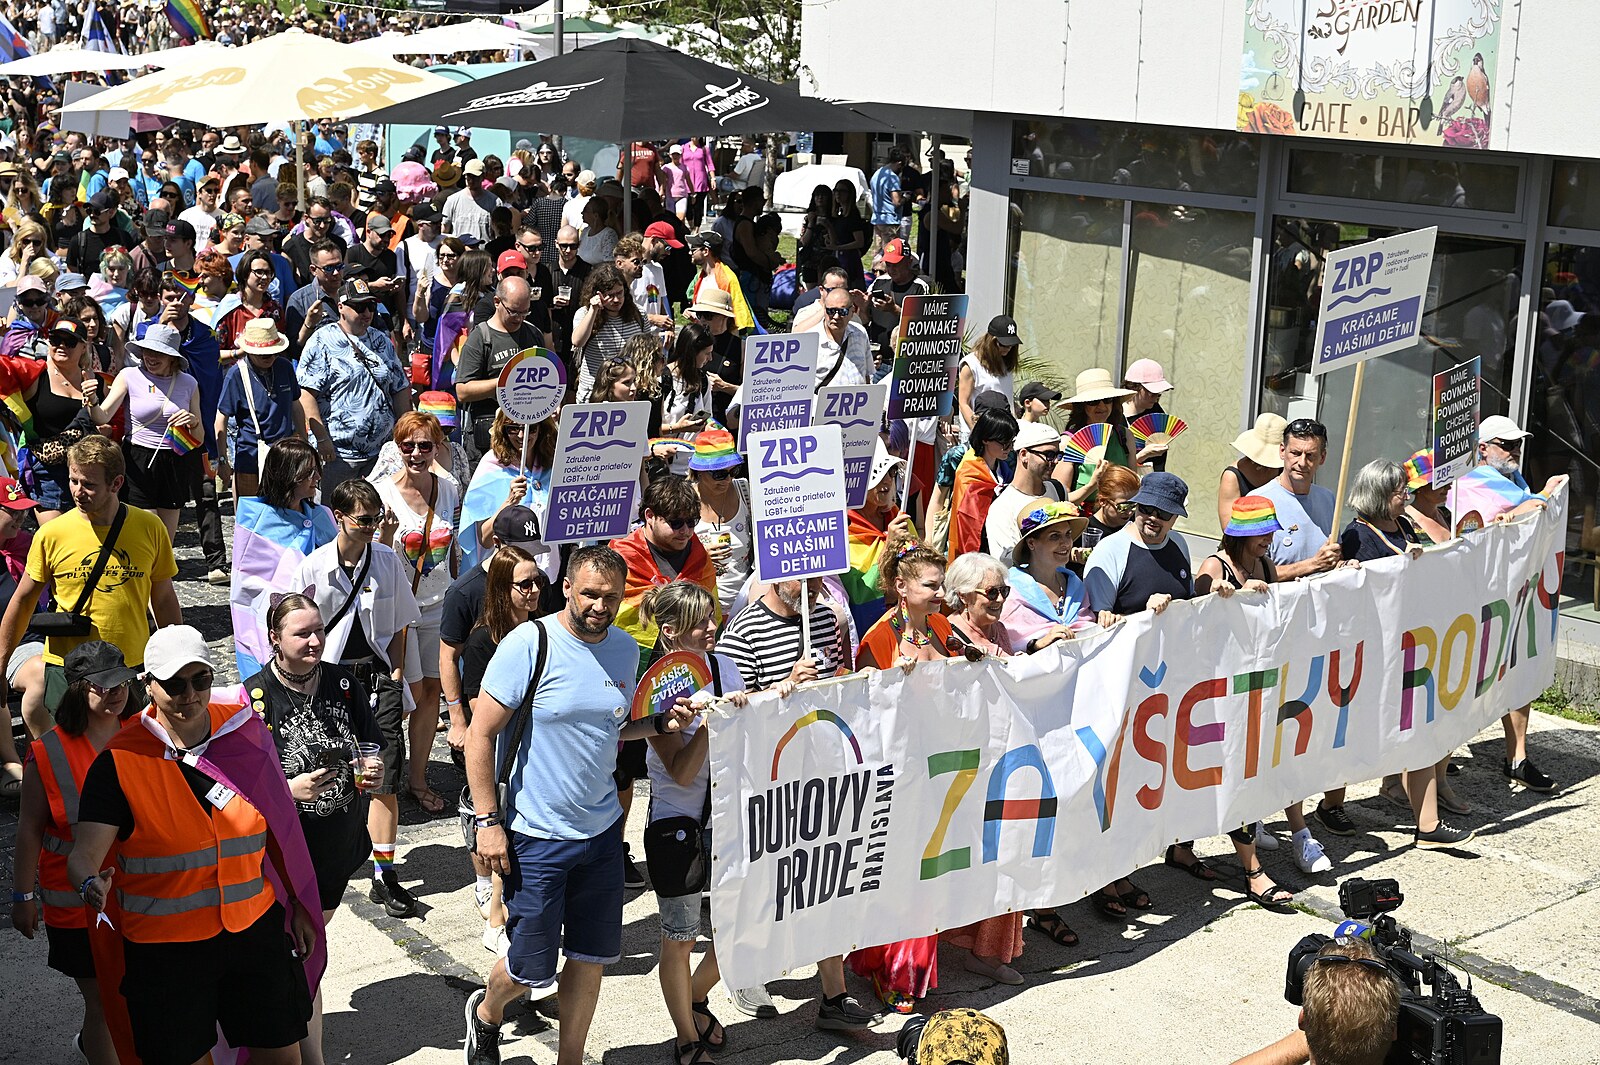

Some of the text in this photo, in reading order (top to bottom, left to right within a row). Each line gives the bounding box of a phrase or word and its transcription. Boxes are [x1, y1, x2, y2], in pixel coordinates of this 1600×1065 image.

[1334, 0, 1423, 55] GARDEN
[305, 68, 398, 114] MATTONI
[699, 85, 761, 118] Schweppes
[1300, 101, 1421, 139] CAFE BAR
[1331, 251, 1384, 294] ZRP
[922, 300, 949, 316] MÁME
[907, 316, 958, 336] ROVNAKÉ
[1341, 307, 1399, 335] KRÁČAME
[900, 339, 959, 357] POVINNOSTI
[1323, 320, 1414, 359] S NAŠIMI DEŤMI
[494, 350, 509, 362] NEW
[754, 339, 801, 365] ZRP
[515, 366, 550, 384] ZRP
[908, 360, 945, 375] CHCEME
[1450, 368, 1468, 386] MÁME
[751, 386, 775, 395] rodičov
[781, 383, 808, 393] priateľov
[752, 377, 782, 386] Združenie
[898, 373, 949, 394] ROVNAKÉ
[1440, 376, 1476, 404] ROVNAKÉ
[500, 388, 521, 419] KRÁČAME
[526, 406, 551, 421] NAŠIMI
[751, 395, 769, 403] LGBT+
[823, 391, 869, 418] ZRP
[903, 394, 937, 413] PRÁVA
[1437, 391, 1479, 420] POVINNOSTI
[748, 403, 806, 420] KRÁČAME
[1445, 410, 1471, 431] CHCEME
[569, 409, 627, 439] ZRP
[750, 418, 801, 433] S NAŠIMI
[1440, 419, 1475, 448] ROVNAKÉ
[565, 454, 601, 464] Združenie
[759, 435, 818, 469] ZRP
[1445, 438, 1470, 460] PRÁVA
[563, 464, 592, 474] rodičov
[600, 461, 633, 473] priateľov
[1436, 465, 1452, 481] ZRP
[562, 475, 585, 484] LGBT+
[557, 485, 628, 504] KRÁČAME
[763, 484, 801, 496] Združenie
[764, 495, 794, 507] rodičov
[802, 490, 836, 503] priateľov
[559, 501, 621, 520] S NAŠIMI
[764, 506, 788, 518] LGBT+
[565, 519, 609, 536] DEŤMI
[764, 516, 838, 540] KRÁČAME
[769, 534, 835, 557] S NAŠIMI
[781, 554, 826, 574] DEŤMI
[604, 680, 619, 688] ING
[650, 663, 690, 690] Láska
[919, 551, 1566, 881] ZA VŠETKY RODINY
[748, 769, 872, 864] DUHOVY
[859, 763, 895, 893] BRATISLAVA
[774, 836, 864, 922] PRIDE
